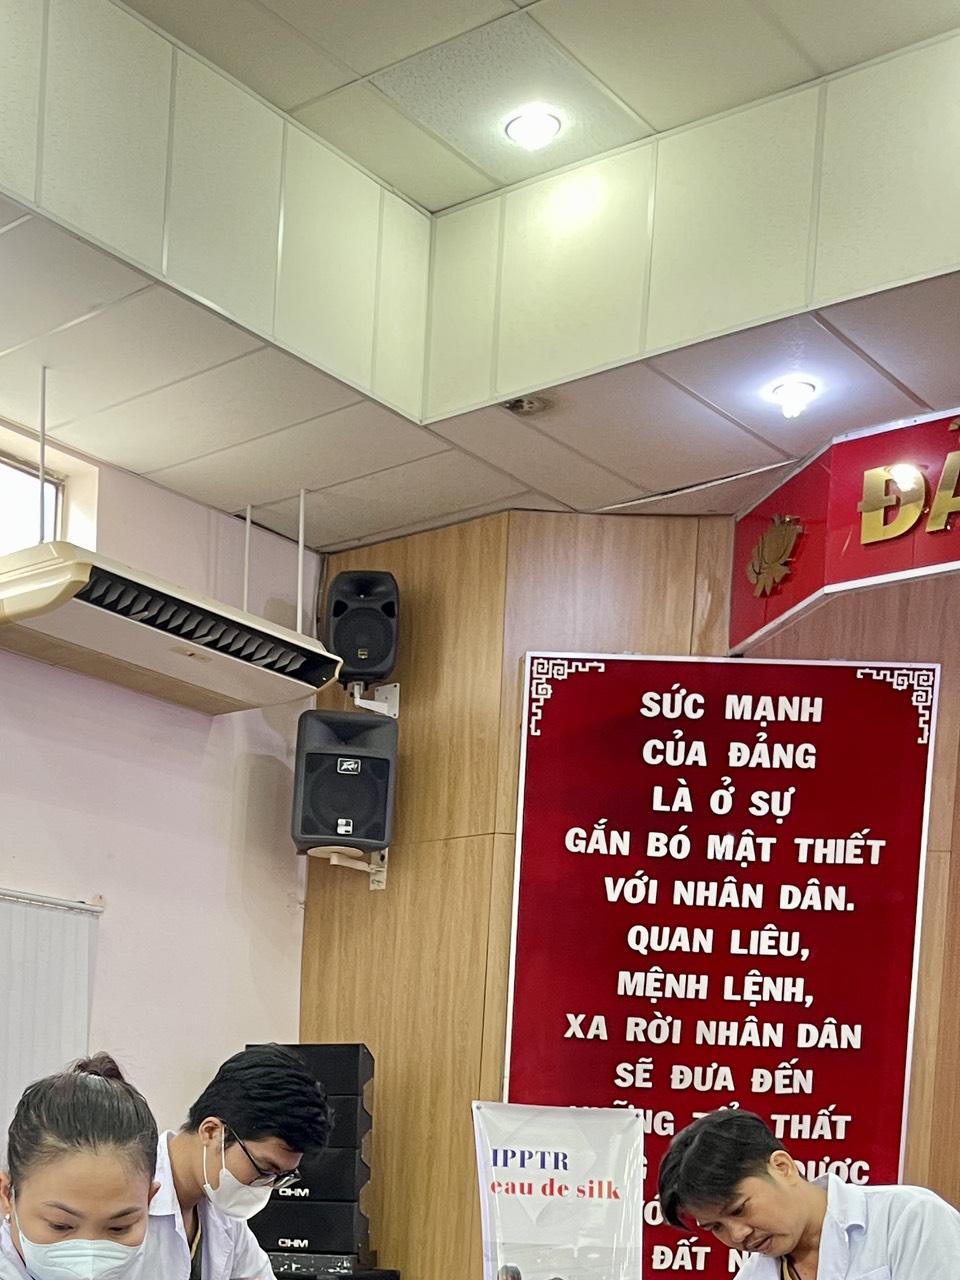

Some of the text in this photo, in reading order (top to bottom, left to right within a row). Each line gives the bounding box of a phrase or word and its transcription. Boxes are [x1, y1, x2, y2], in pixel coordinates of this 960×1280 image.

[639, 683, 823, 728] SỨC MẠNH
[642, 729, 817, 769] CỦA ĐẢNG
[652, 776, 796, 825] LÀ Ở SỰ
[565, 818, 886, 868] GẮN BÓ MẬT THIẾT
[604, 870, 855, 911] VỚI NHÂN DÂN.
[627, 923, 810, 962] QUAN LIÊU,
[617, 965, 814, 1008] MỆNH LỆNH,
[564, 1011, 862, 1049] XA RỜI NHÂN DÂN
[614, 1057, 813, 1094] SẼ ĐƯA ĐẾN
[771, 1104, 851, 1140] THẤT
[492, 1148, 569, 1171] IPPTR
[490, 1177, 621, 1200] eau de silk
[278, 1238, 309, 1248] OHM
[651, 1236, 711, 1271] ĐẤT
